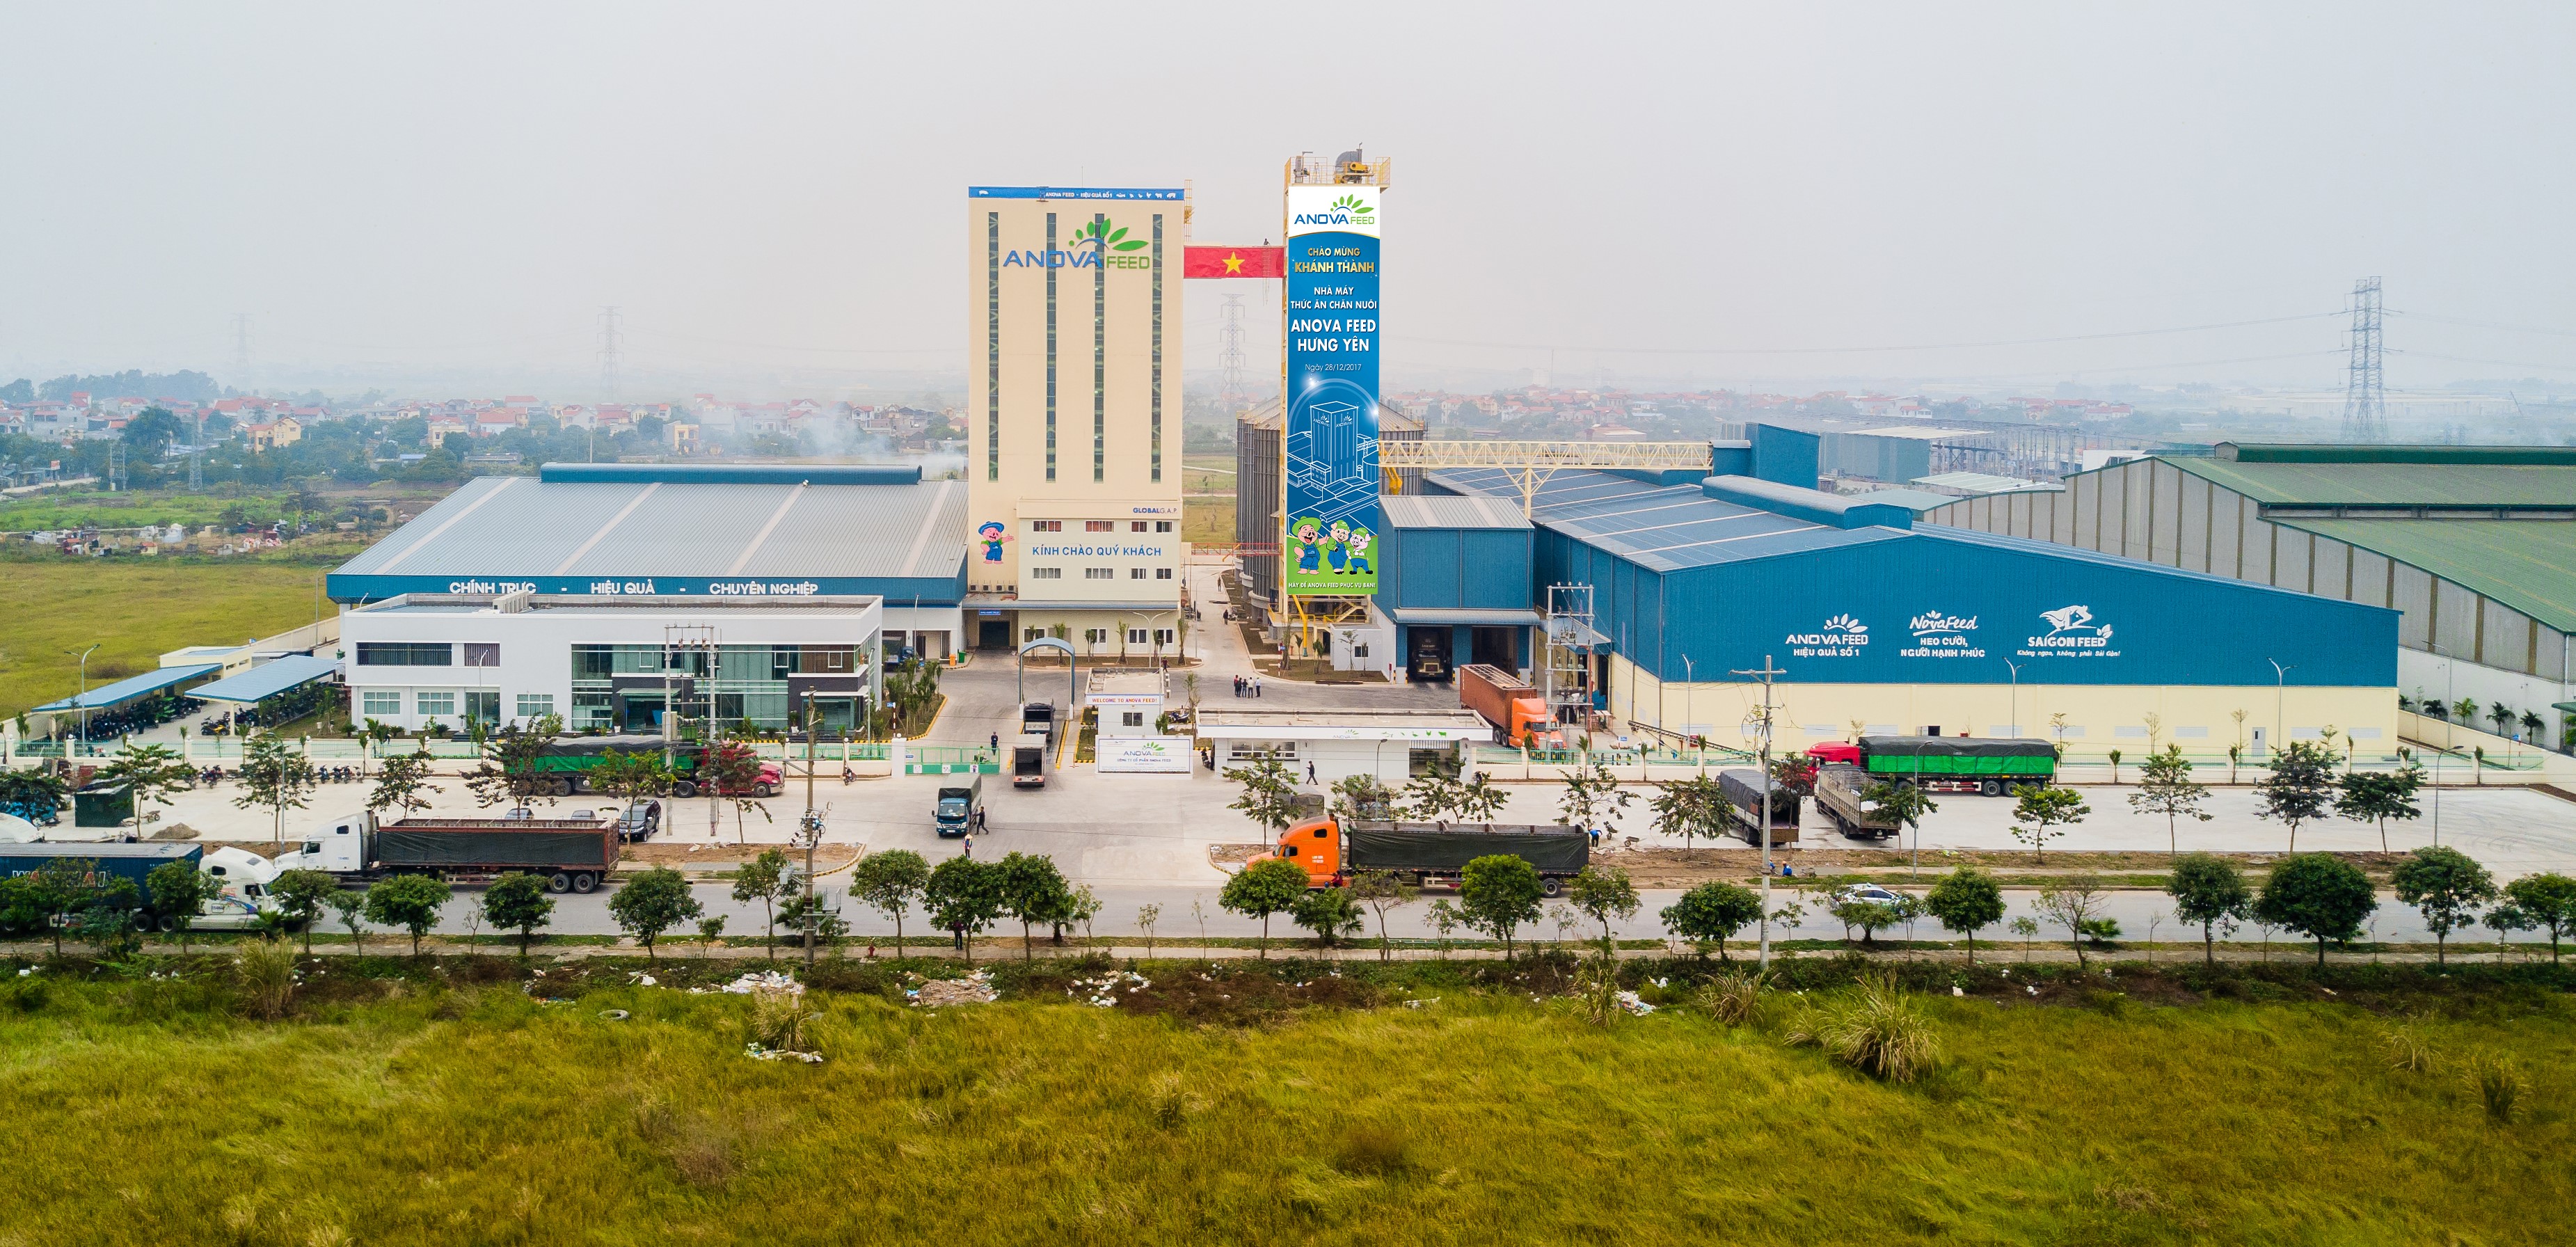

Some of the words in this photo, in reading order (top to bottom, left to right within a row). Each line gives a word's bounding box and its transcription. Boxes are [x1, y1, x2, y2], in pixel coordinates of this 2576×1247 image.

[1294, 214, 1349, 224] ANOVA
[1308, 246, 1332, 256] CHÀO
[1334, 246, 1360, 256] MỪNG
[1003, 251, 1103, 268] ANOVA
[1106, 256, 1150, 269] FEED
[1294, 259, 1334, 273] KHÁNH
[1337, 259, 1374, 273] THÀNH
[1314, 285, 1333, 295] NHÀ
[1335, 285, 1354, 295] MÁY
[1290, 299, 1312, 309] THỨC
[1314, 299, 1326, 309] ĂN
[1329, 299, 1353, 309] CHĂN
[1355, 299, 1377, 309] NUÔI
[1291, 319, 1342, 333] ANOVA
[1346, 319, 1376, 333] FEED
[1298, 337, 1338, 351] HƯNG
[1343, 335, 1369, 351] YÊN
[1033, 544, 1059, 555] KÍNH
[1062, 544, 1092, 555] CHÀO
[1097, 544, 1119, 557] QUÝ
[1123, 544, 1161, 556] KHÁCH
[450, 579, 495, 594] CHÍNH
[591, 579, 621, 595] HIỆU
[624, 579, 655, 594] QUẢ
[709, 580, 765, 594] CHUYÊN
[770, 580, 818, 596] NGHIỆP
[1786, 634, 1841, 644] ANOVA
[1842, 635, 1868, 645] FEED
[2028, 637, 2075, 646] SAIGON
[2077, 637, 2106, 646] FEED
[1793, 646, 1815, 658] HIỆU
[1817, 646, 1837, 656] QUẢ
[1840, 646, 1853, 656] SỐ
[1901, 647, 1930, 657] NGƯỜI
[1932, 649, 1957, 658] HẠNH
[1960, 646, 1985, 657] PHÚC
